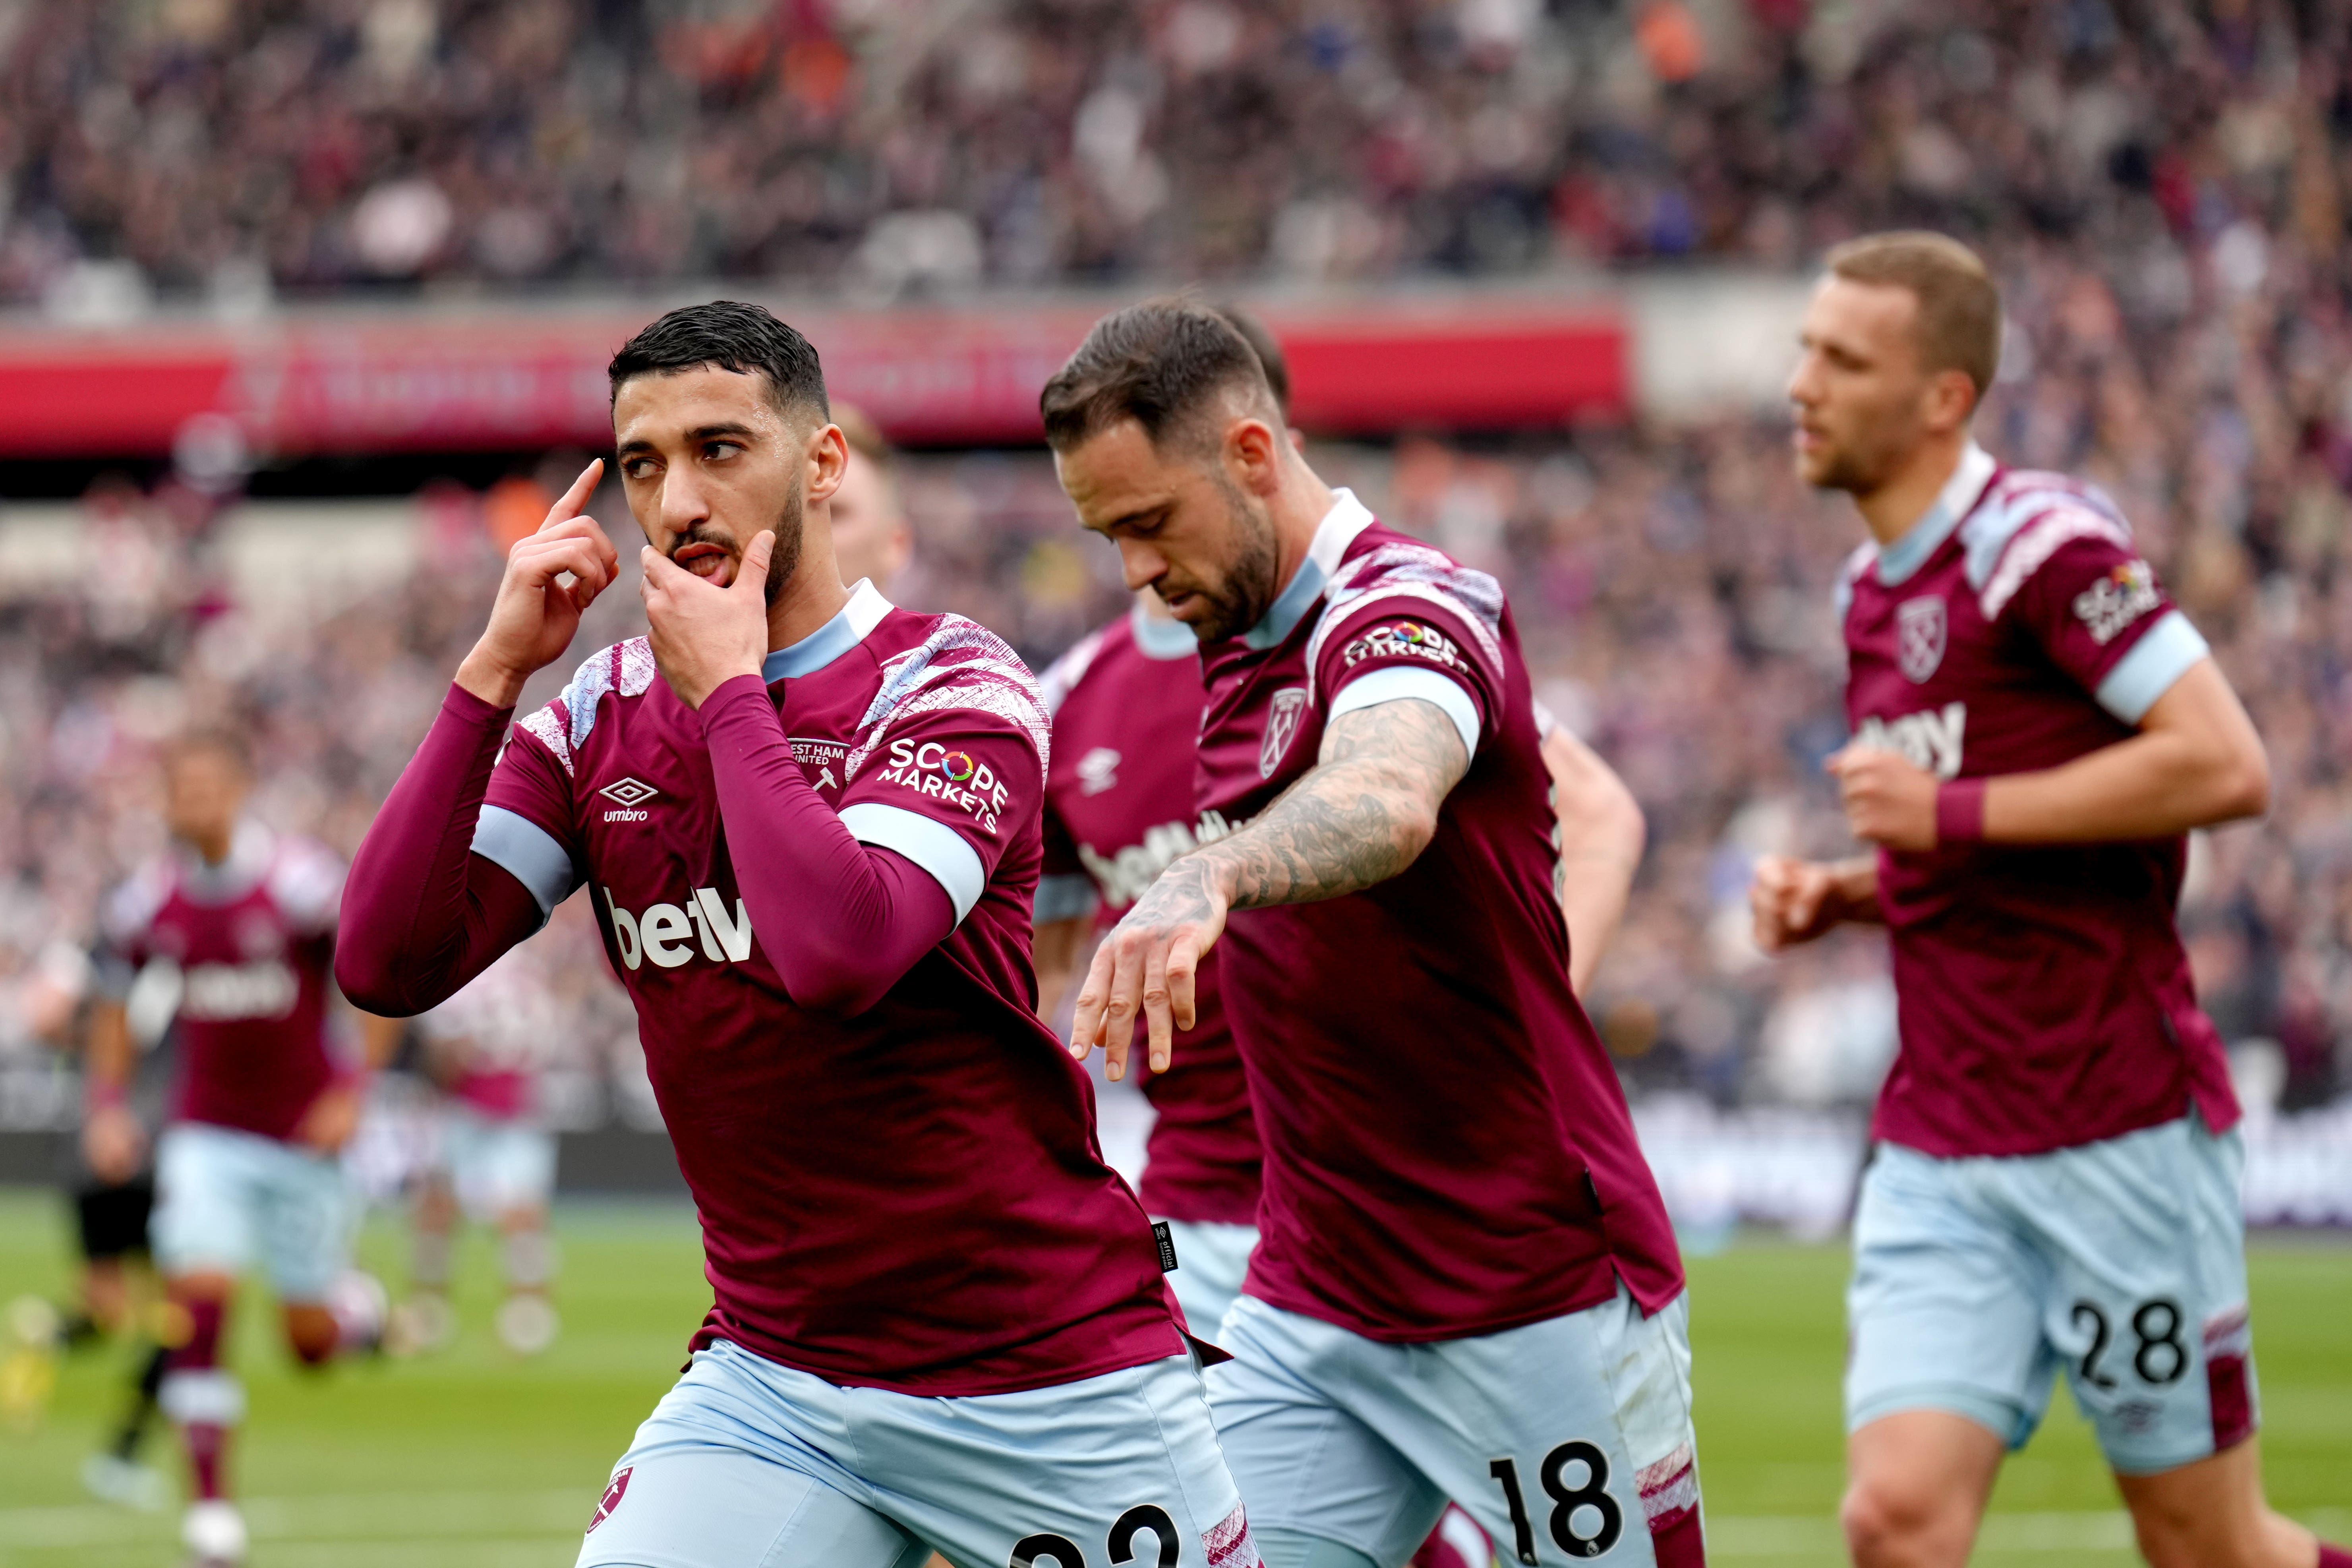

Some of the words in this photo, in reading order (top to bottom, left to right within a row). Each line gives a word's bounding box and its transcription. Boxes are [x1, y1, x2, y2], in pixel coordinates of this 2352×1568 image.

[791, 744, 812, 754] EST
[814, 745, 844, 760] HAM
[795, 755, 829, 765] NITED
[889, 738, 1009, 816] SCOPE
[603, 808, 648, 822] umbro
[876, 768, 996, 834] MARKETS
[1163, 1241, 1174, 1268] official
[2071, 1299, 2188, 1392] 28
[1489, 1439, 1624, 1567] 18
